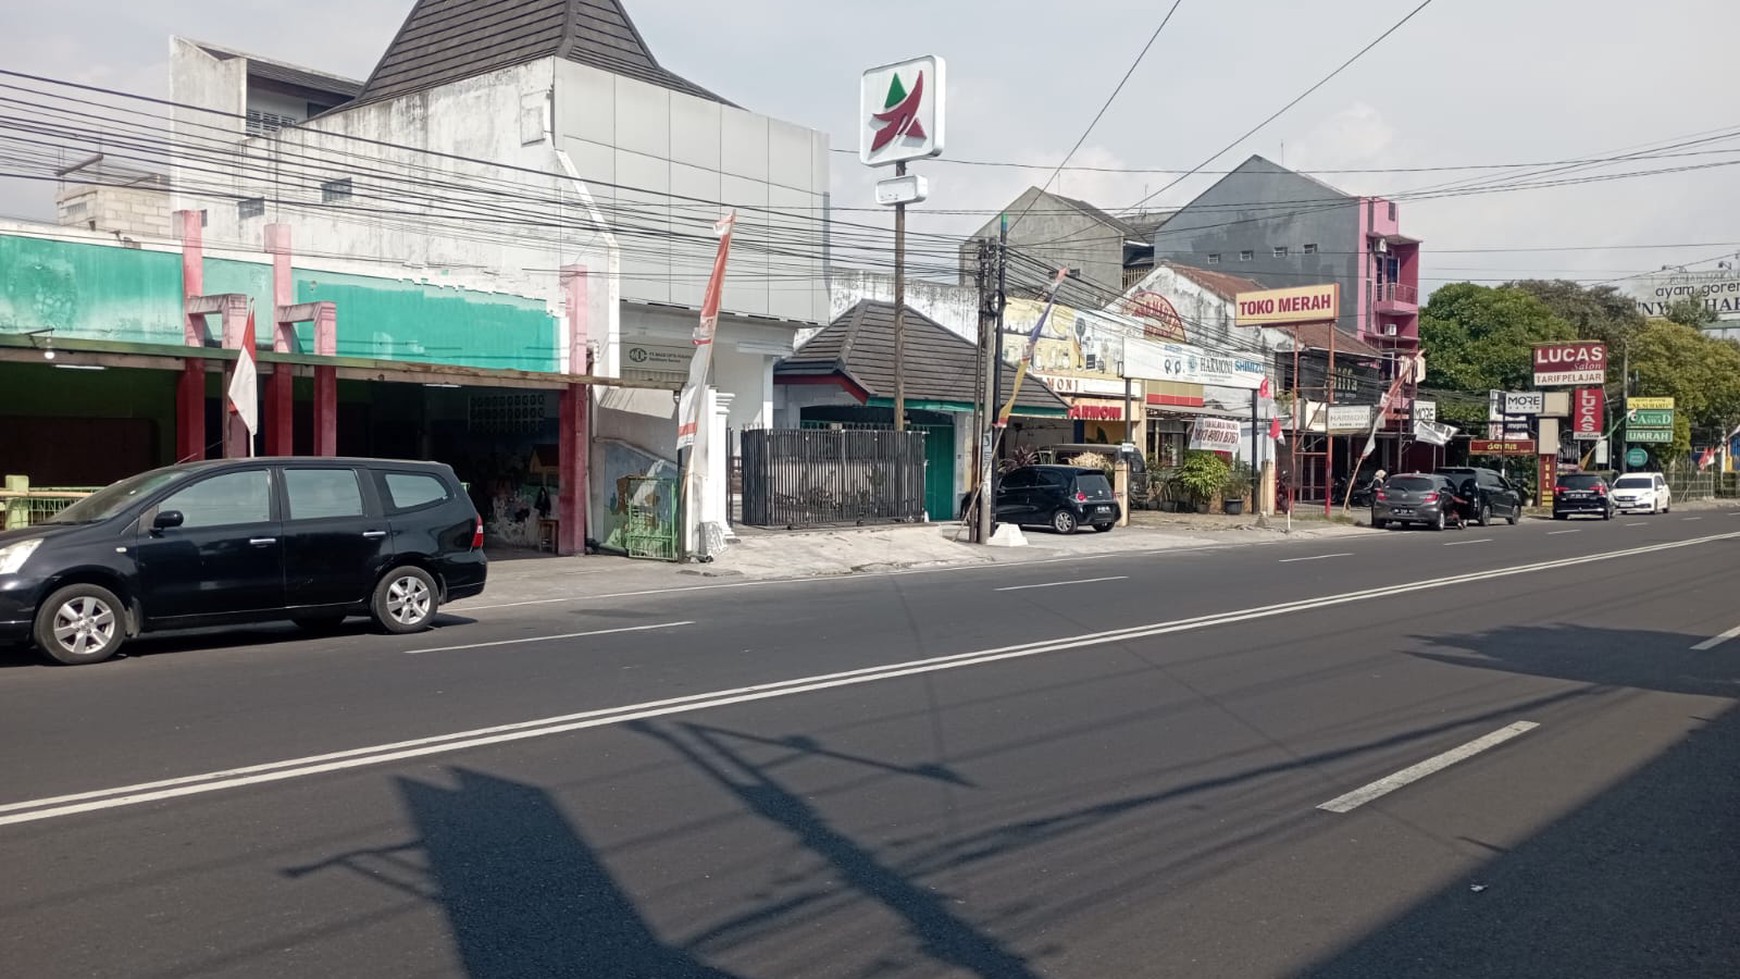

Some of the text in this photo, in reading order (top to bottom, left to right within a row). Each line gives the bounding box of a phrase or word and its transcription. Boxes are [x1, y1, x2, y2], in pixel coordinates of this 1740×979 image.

[1655, 285, 1695, 299] ayam
[1240, 294, 1331, 316] TOKO MERAH
[1537, 346, 1603, 364] LUCAS
[1200, 357, 1265, 375] HARMONI SHIMIZU
[1507, 396, 1540, 406] MORE
[1580, 389, 1597, 432] LUCAS
[1629, 432, 1669, 441] UMRAH
